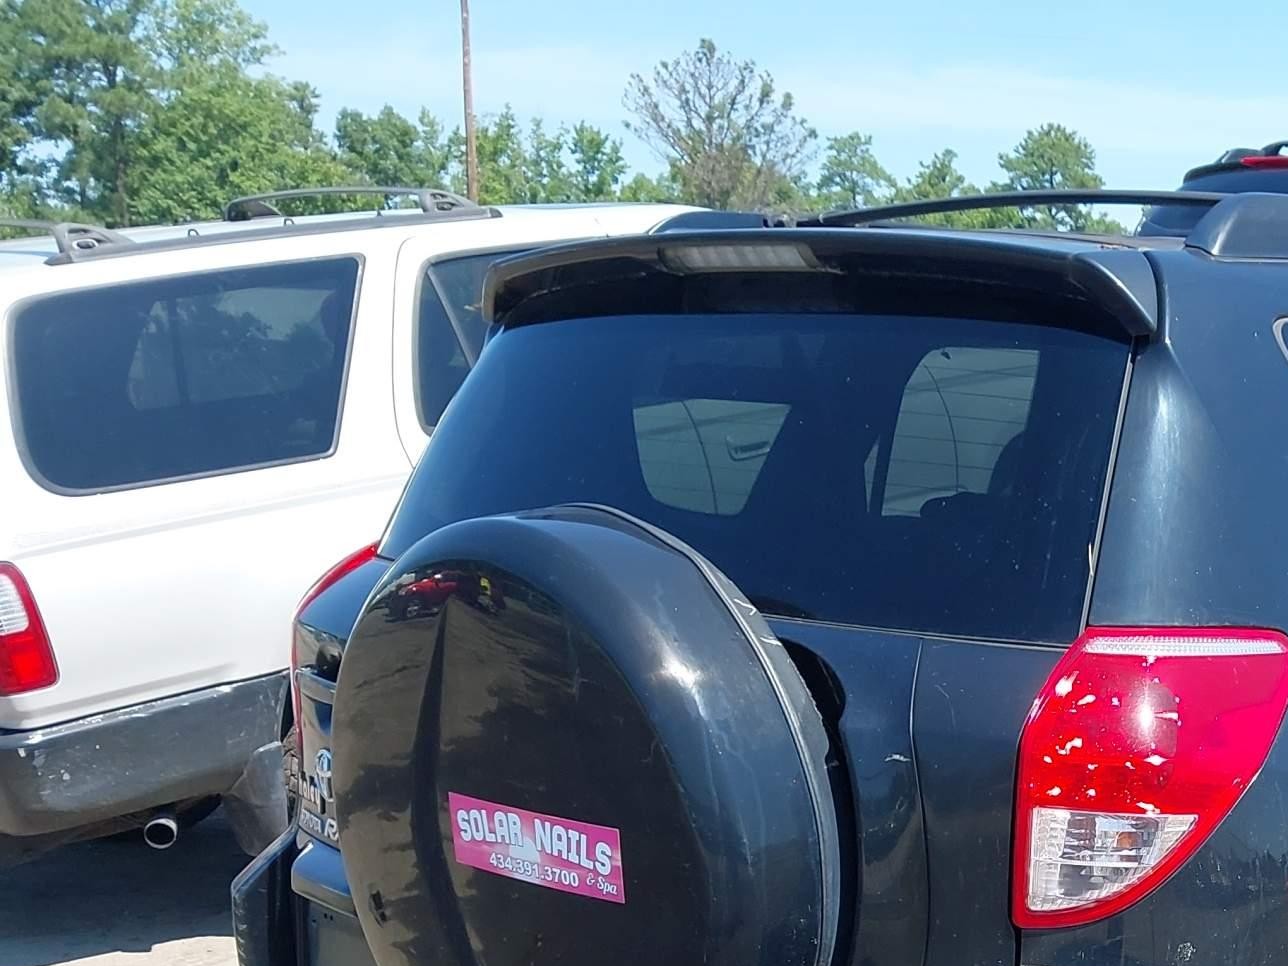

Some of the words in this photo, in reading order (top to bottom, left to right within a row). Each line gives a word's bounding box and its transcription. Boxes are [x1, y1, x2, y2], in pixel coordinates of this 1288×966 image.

[456, 809, 523, 848] SOLAR
[533, 817, 613, 877] NAILS
[489, 852, 579, 887] 434.391.3700
[586, 872, 596, 886] &
[596, 876, 618, 896] Spa
